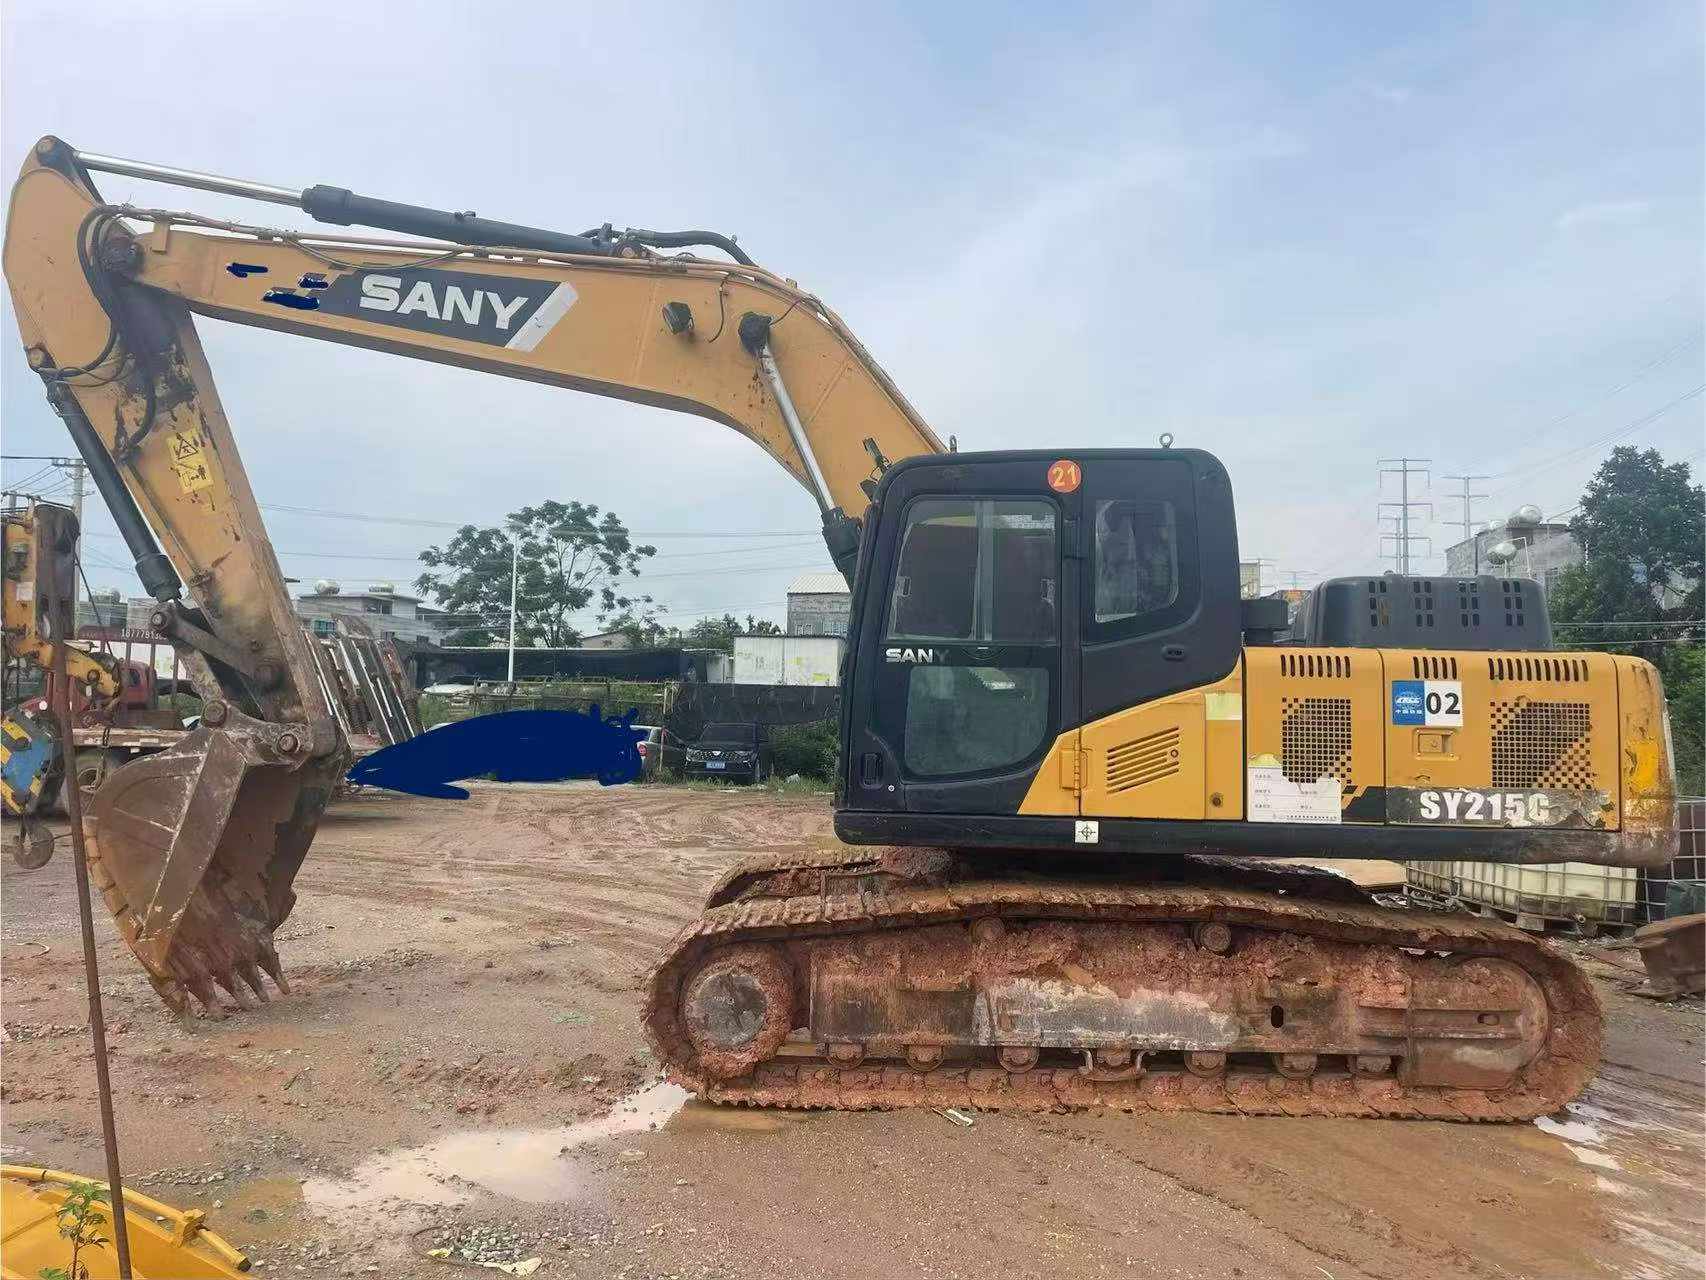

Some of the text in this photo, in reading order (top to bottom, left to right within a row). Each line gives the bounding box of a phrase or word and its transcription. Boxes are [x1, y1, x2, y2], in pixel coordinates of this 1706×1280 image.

[360, 274, 529, 330] SANY
[1051, 463, 1077, 487] 21
[1426, 692, 1461, 715] 02
[1419, 791, 1550, 821] SY215C
